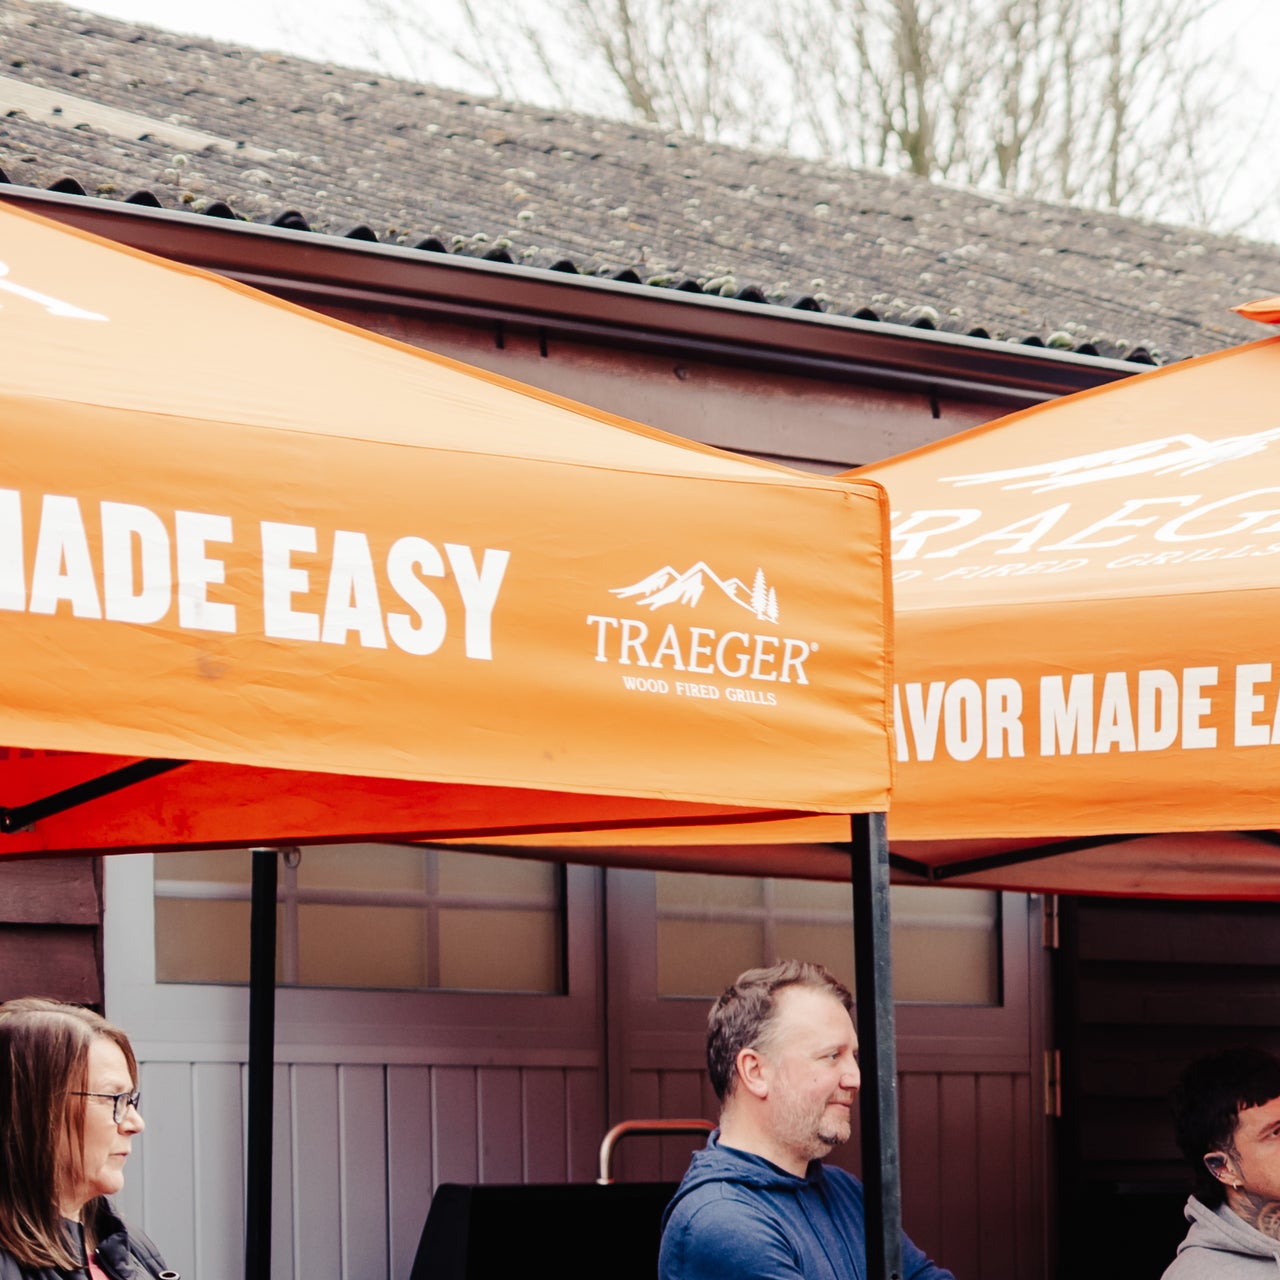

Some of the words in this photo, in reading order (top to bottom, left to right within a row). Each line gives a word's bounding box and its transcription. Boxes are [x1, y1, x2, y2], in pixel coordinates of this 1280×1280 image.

[0, 488, 236, 633] ADE
[260, 520, 511, 660] EASY
[586, 614, 809, 685] TRAEGER
[622, 675, 669, 694] WOOD
[675, 682, 720, 699] FIRED
[725, 687, 777, 706] GRILLS
[893, 678, 1025, 762] VOR
[1039, 667, 1218, 756] MADE
